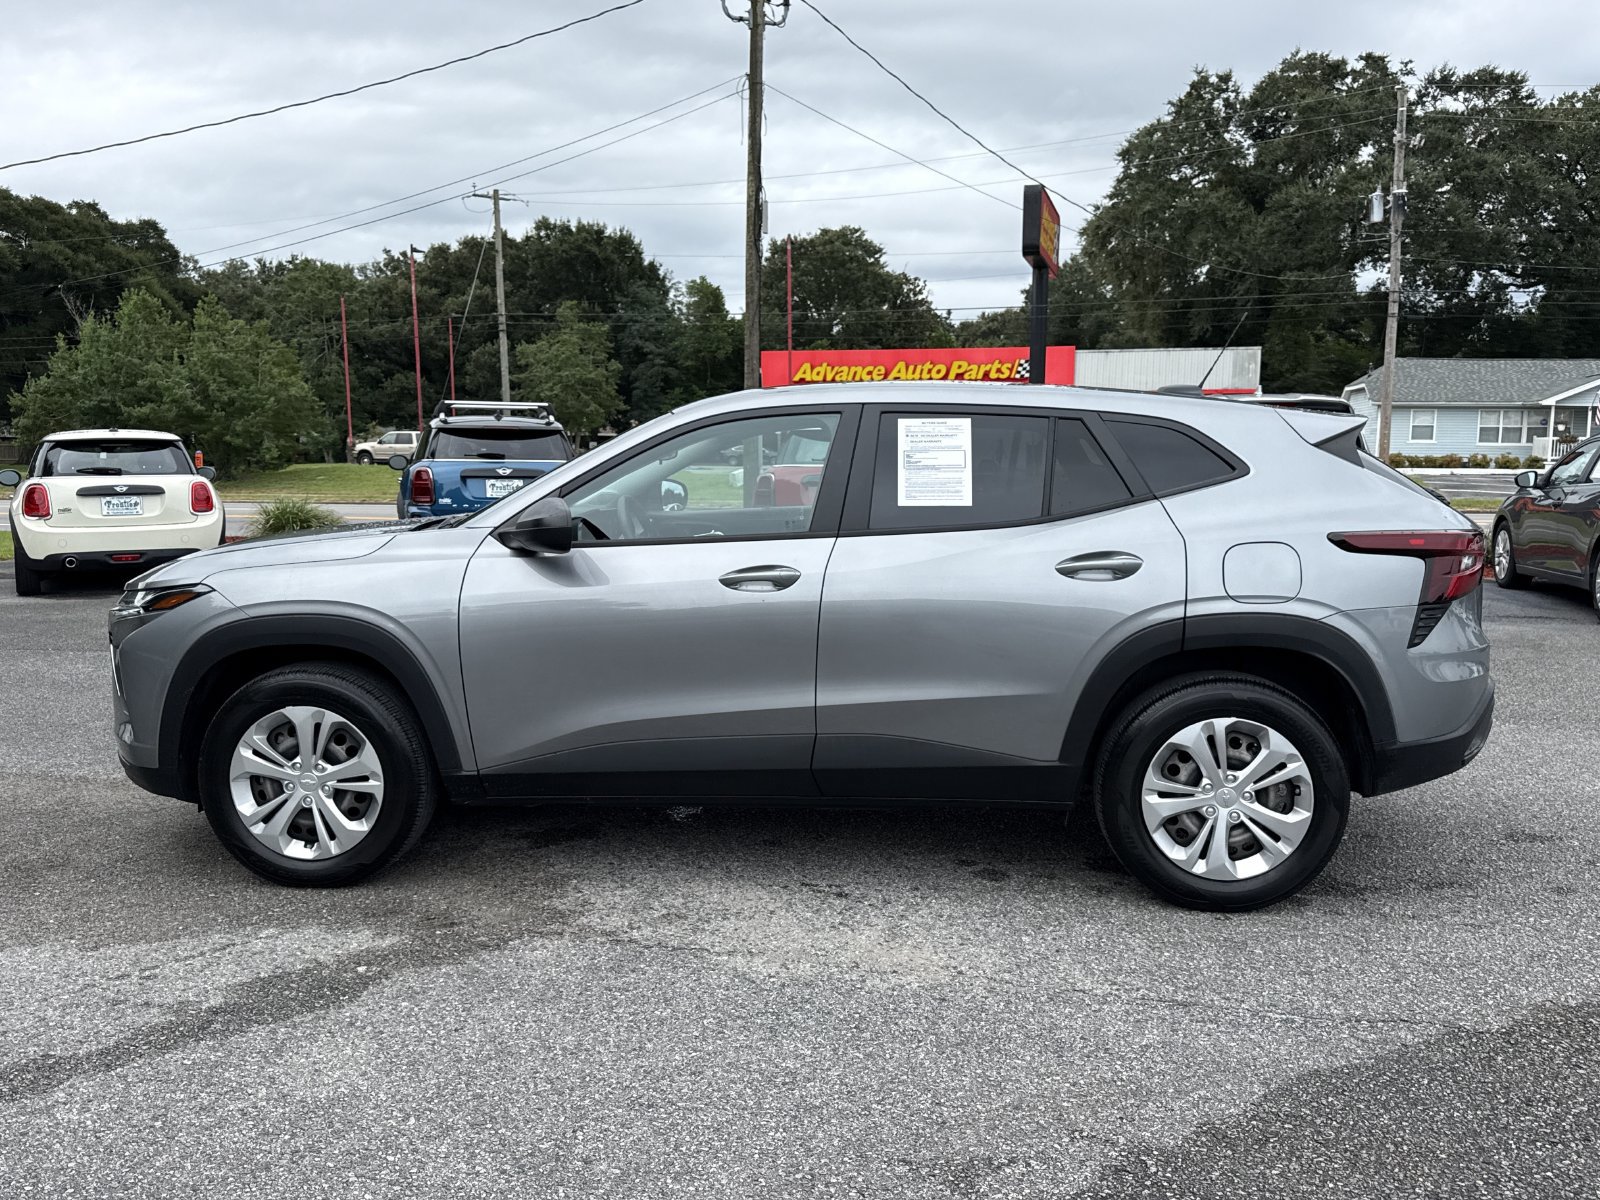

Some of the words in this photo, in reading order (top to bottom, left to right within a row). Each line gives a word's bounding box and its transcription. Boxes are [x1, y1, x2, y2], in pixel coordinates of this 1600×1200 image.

[792, 362, 886, 382] Advance
[887, 361, 947, 381] Auto
[947, 359, 1012, 380] Parts
